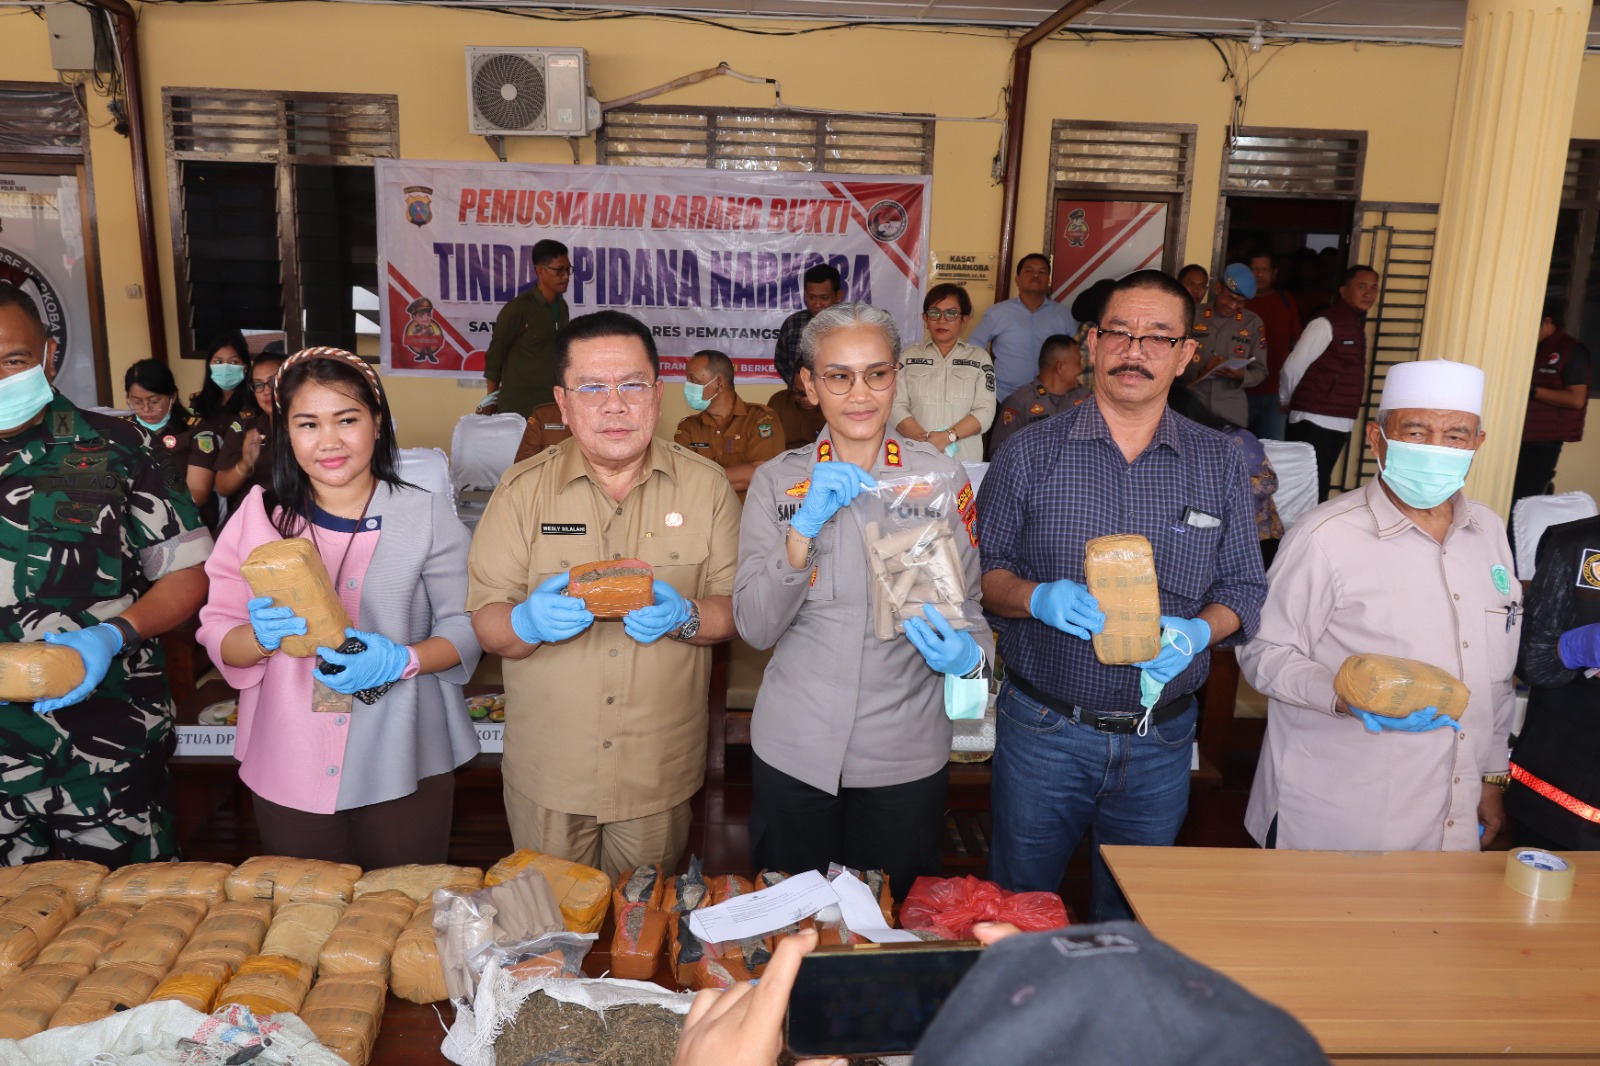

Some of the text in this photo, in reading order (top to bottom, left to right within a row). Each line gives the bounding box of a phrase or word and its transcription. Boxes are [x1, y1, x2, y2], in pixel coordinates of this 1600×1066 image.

[458, 188, 647, 229] PEMUSNAHAN
[651, 194, 763, 232] BARANG
[767, 197, 851, 235] BUKTI
[936, 263, 989, 271] RESNARKOBA
[433, 242, 539, 304] TINDA
[573, 246, 701, 308] PIDANA
[652, 326, 681, 337] RES
[685, 327, 780, 339] PEMATANGS
[660, 362, 687, 370] TRAN
[740, 364, 777, 372] BERKE
[176, 733, 235, 744] ETUA DP
